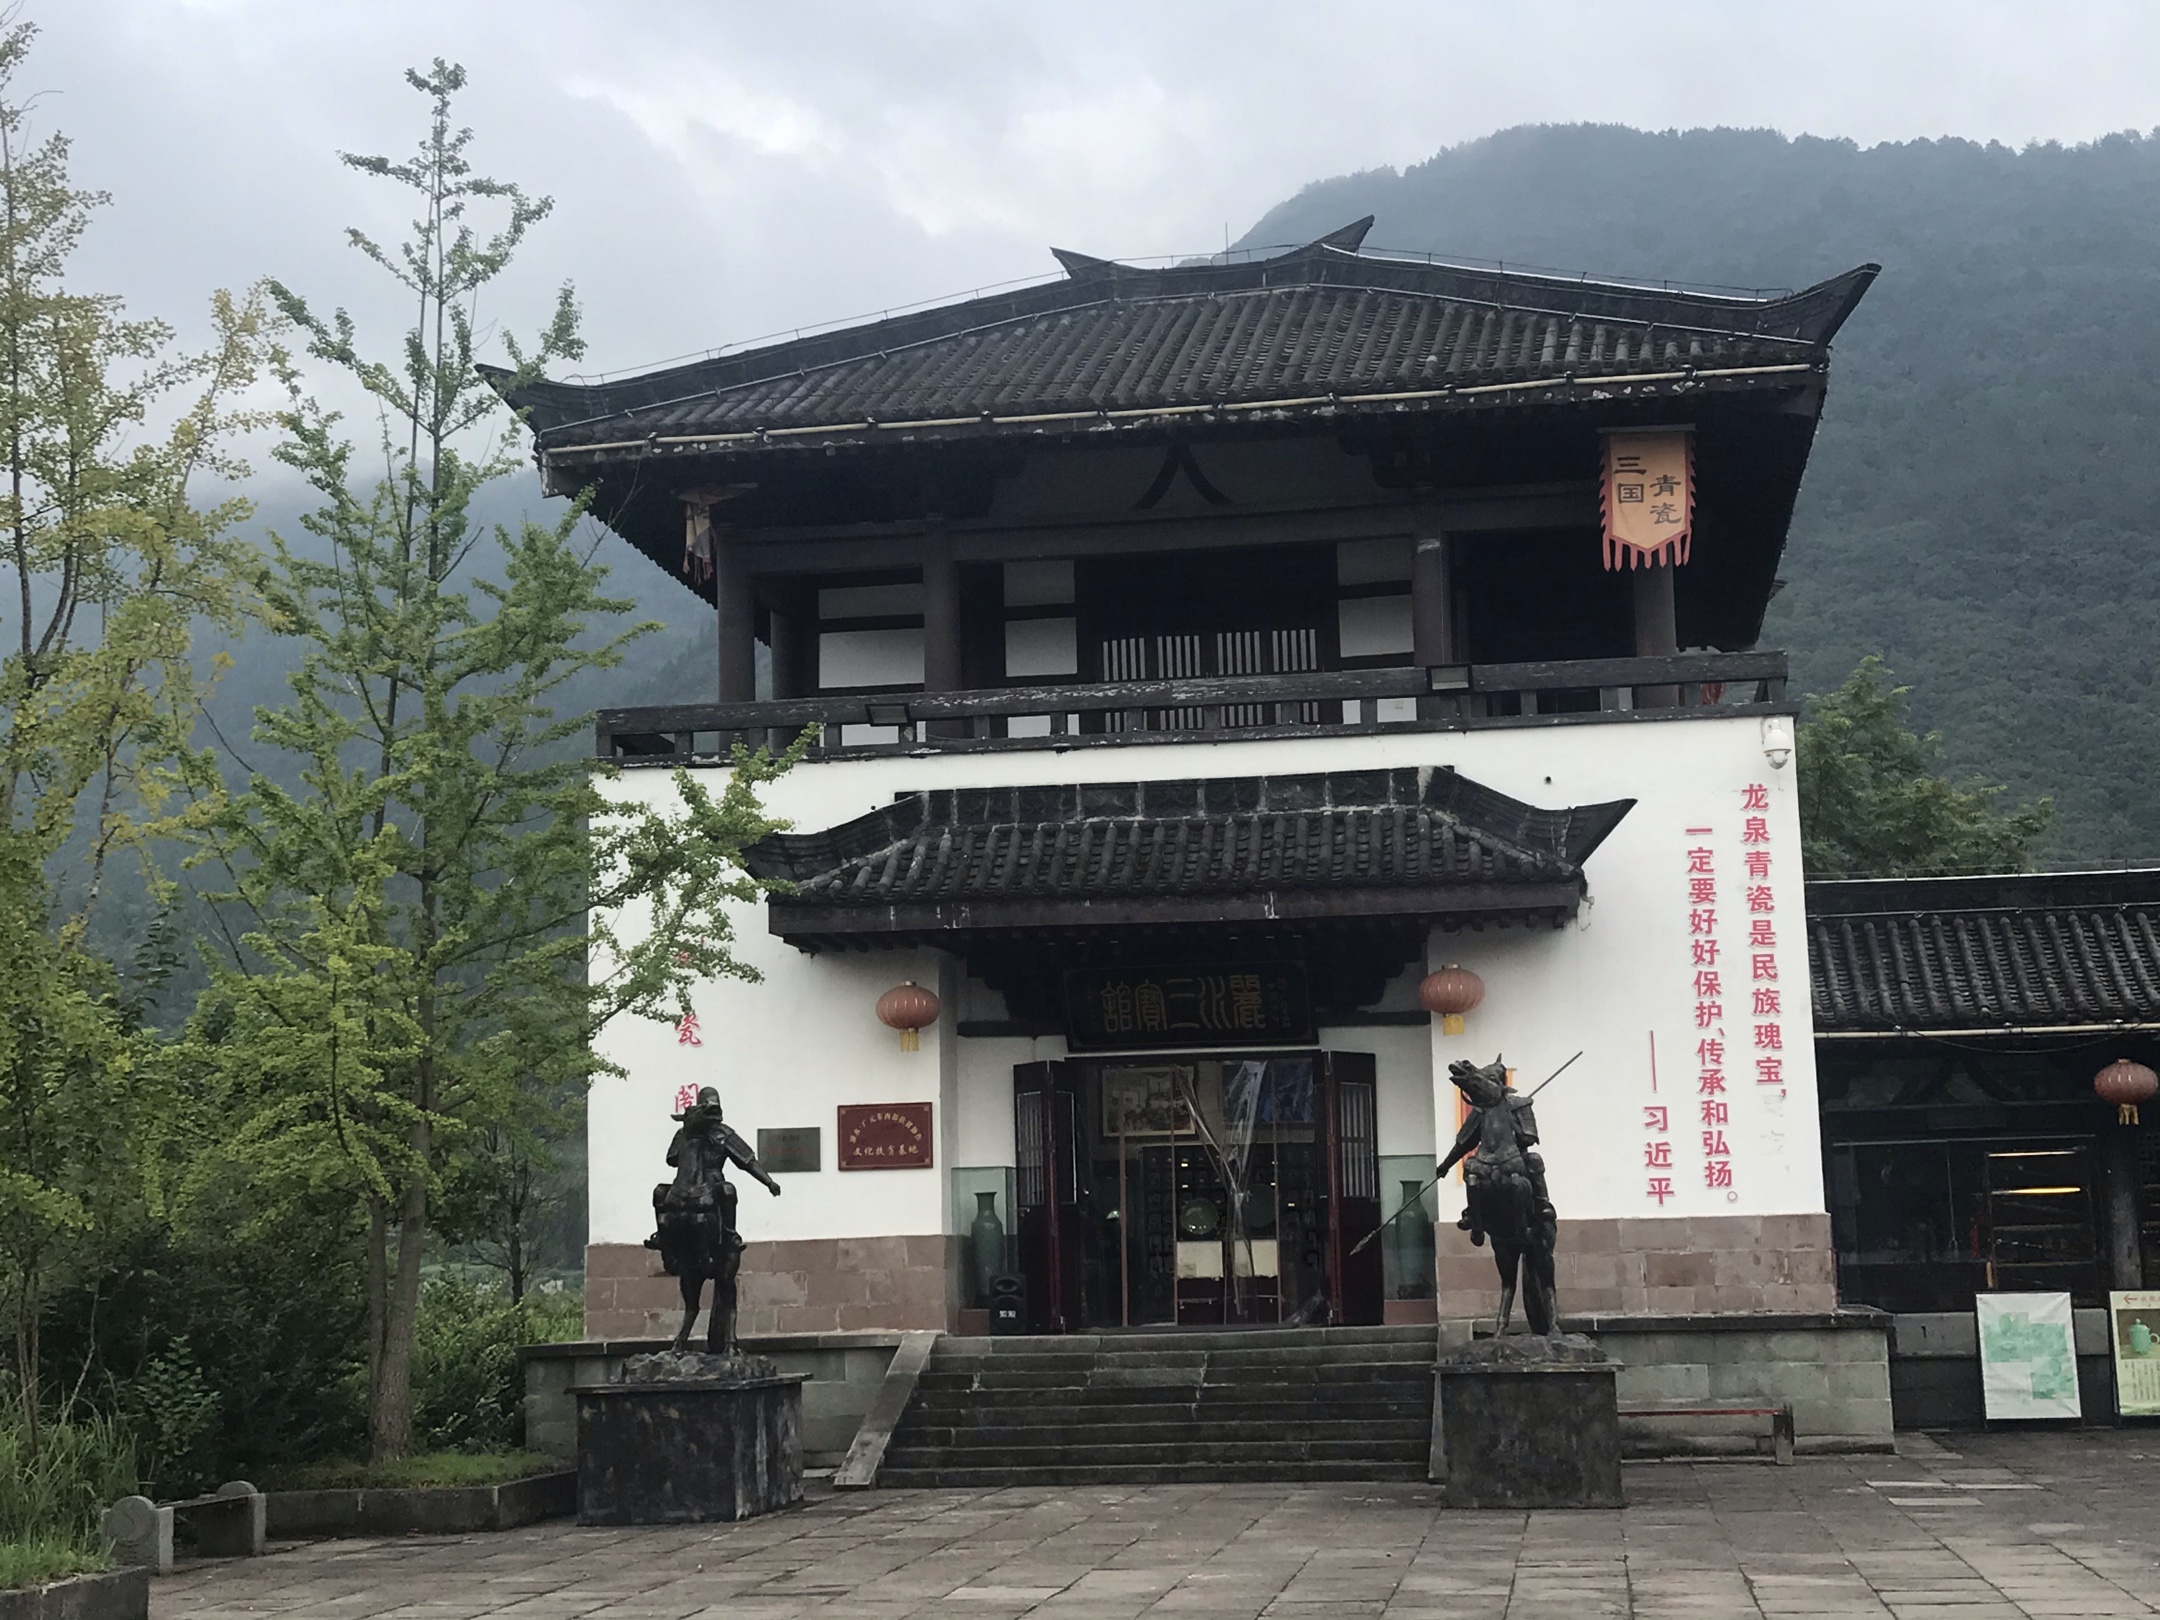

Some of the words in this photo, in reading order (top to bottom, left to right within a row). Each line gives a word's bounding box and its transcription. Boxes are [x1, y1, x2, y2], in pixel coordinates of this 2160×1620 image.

[1614, 456, 1647, 504] 三国
[1650, 474, 1682, 524] 青瓷
[1685, 826, 1738, 1202] 一定要好好保护、传承和弘扬。
[1741, 783, 1787, 1099] 龙泉青瓷是民族瑰宝，
